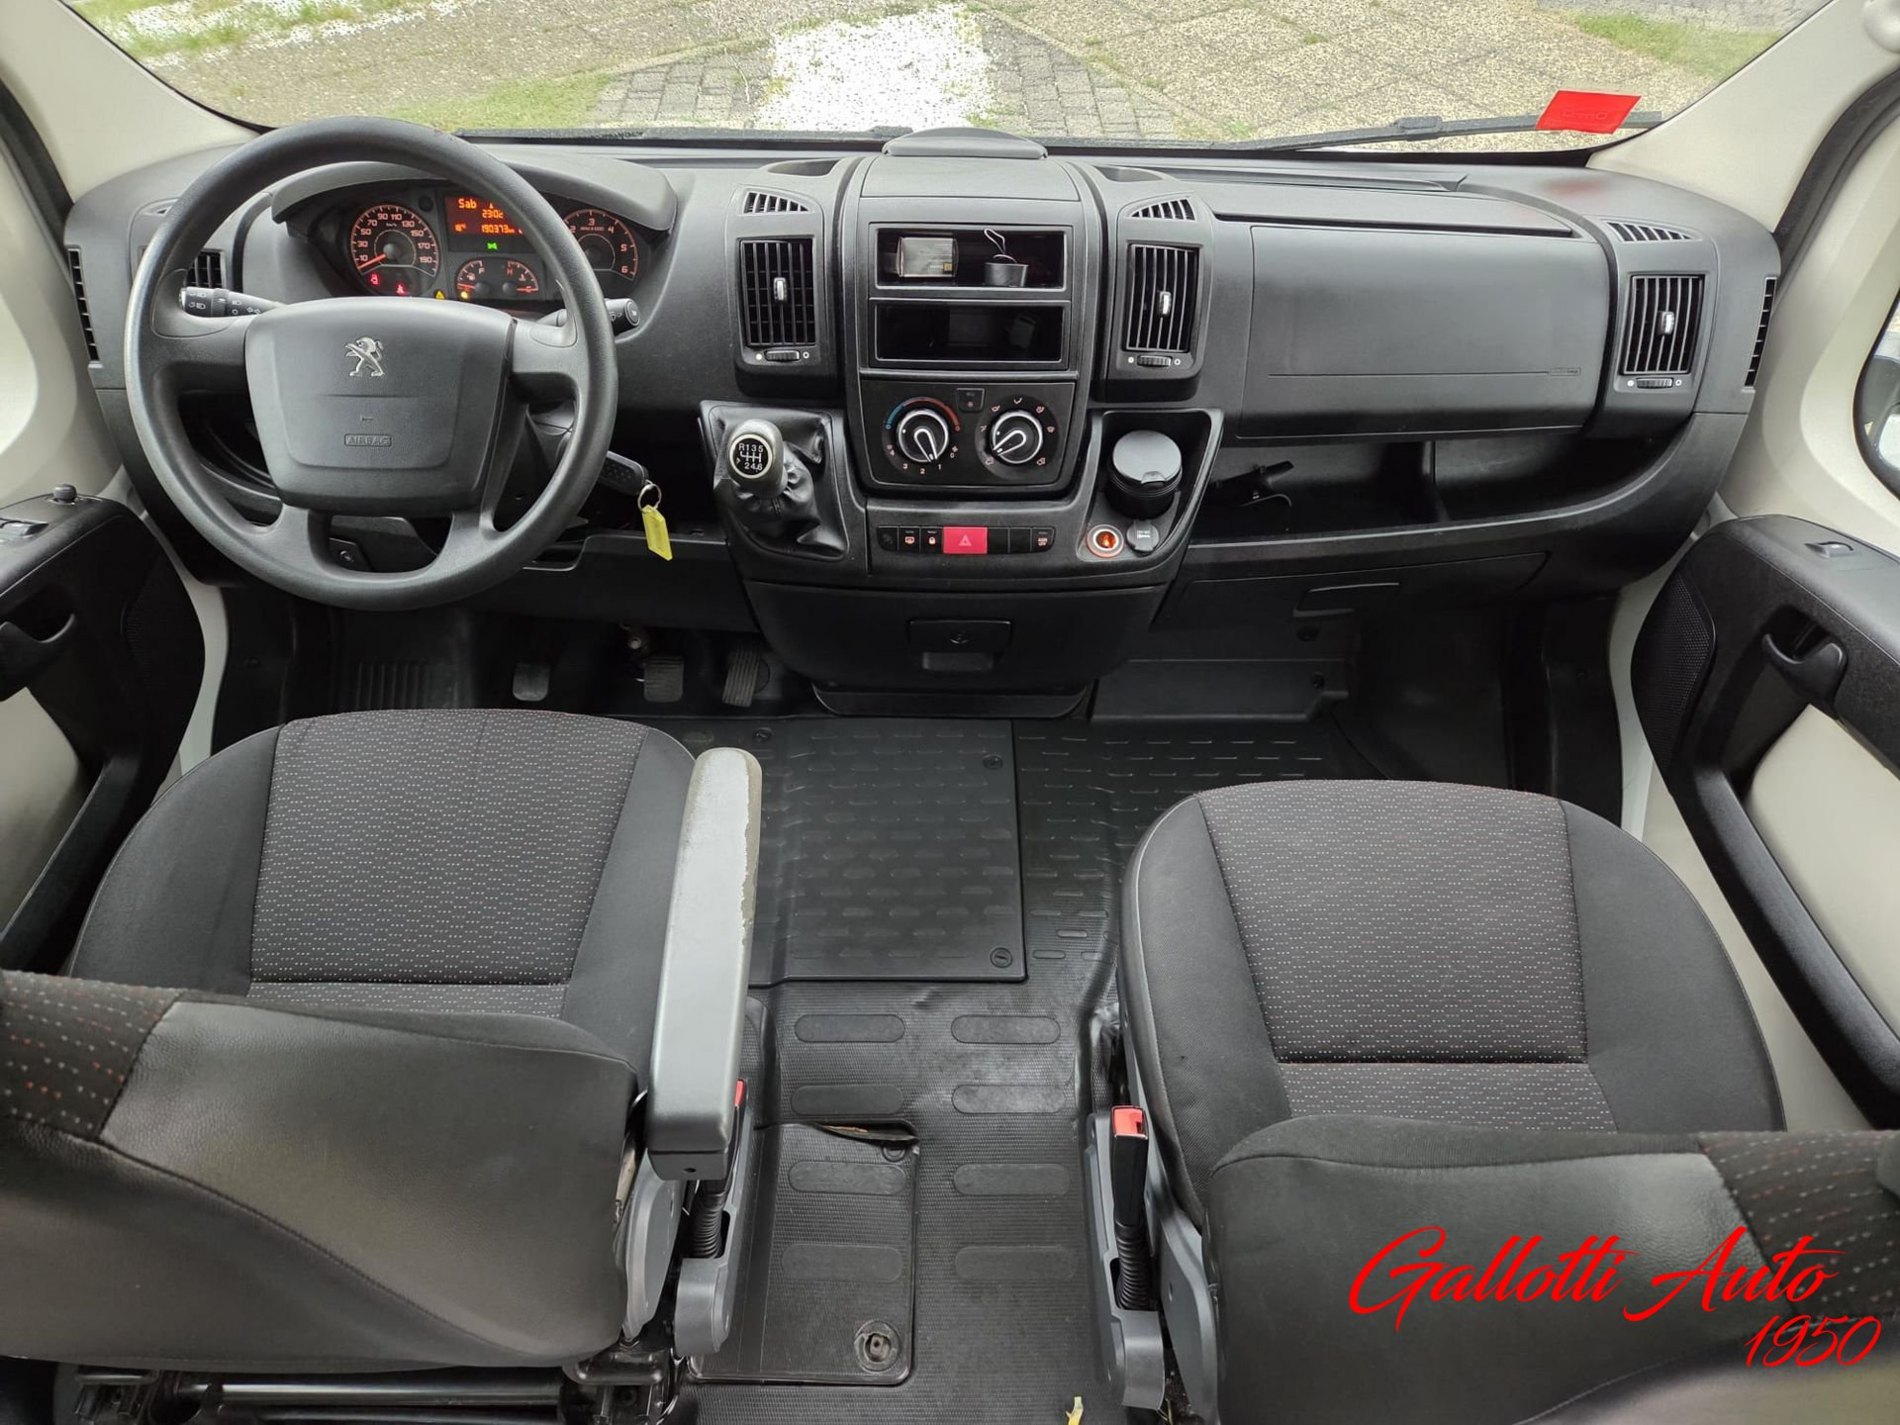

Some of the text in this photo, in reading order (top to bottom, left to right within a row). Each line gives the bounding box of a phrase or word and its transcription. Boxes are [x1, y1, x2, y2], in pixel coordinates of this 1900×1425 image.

[458, 198, 477, 209] Sab
[391, 213, 402, 221] 110
[367, 219, 378, 227] 70
[588, 218, 595, 226] 3
[360, 228, 372, 236] 50
[607, 226, 614, 234] 4
[620, 243, 627, 252] 5
[621, 265, 628, 273] 6
